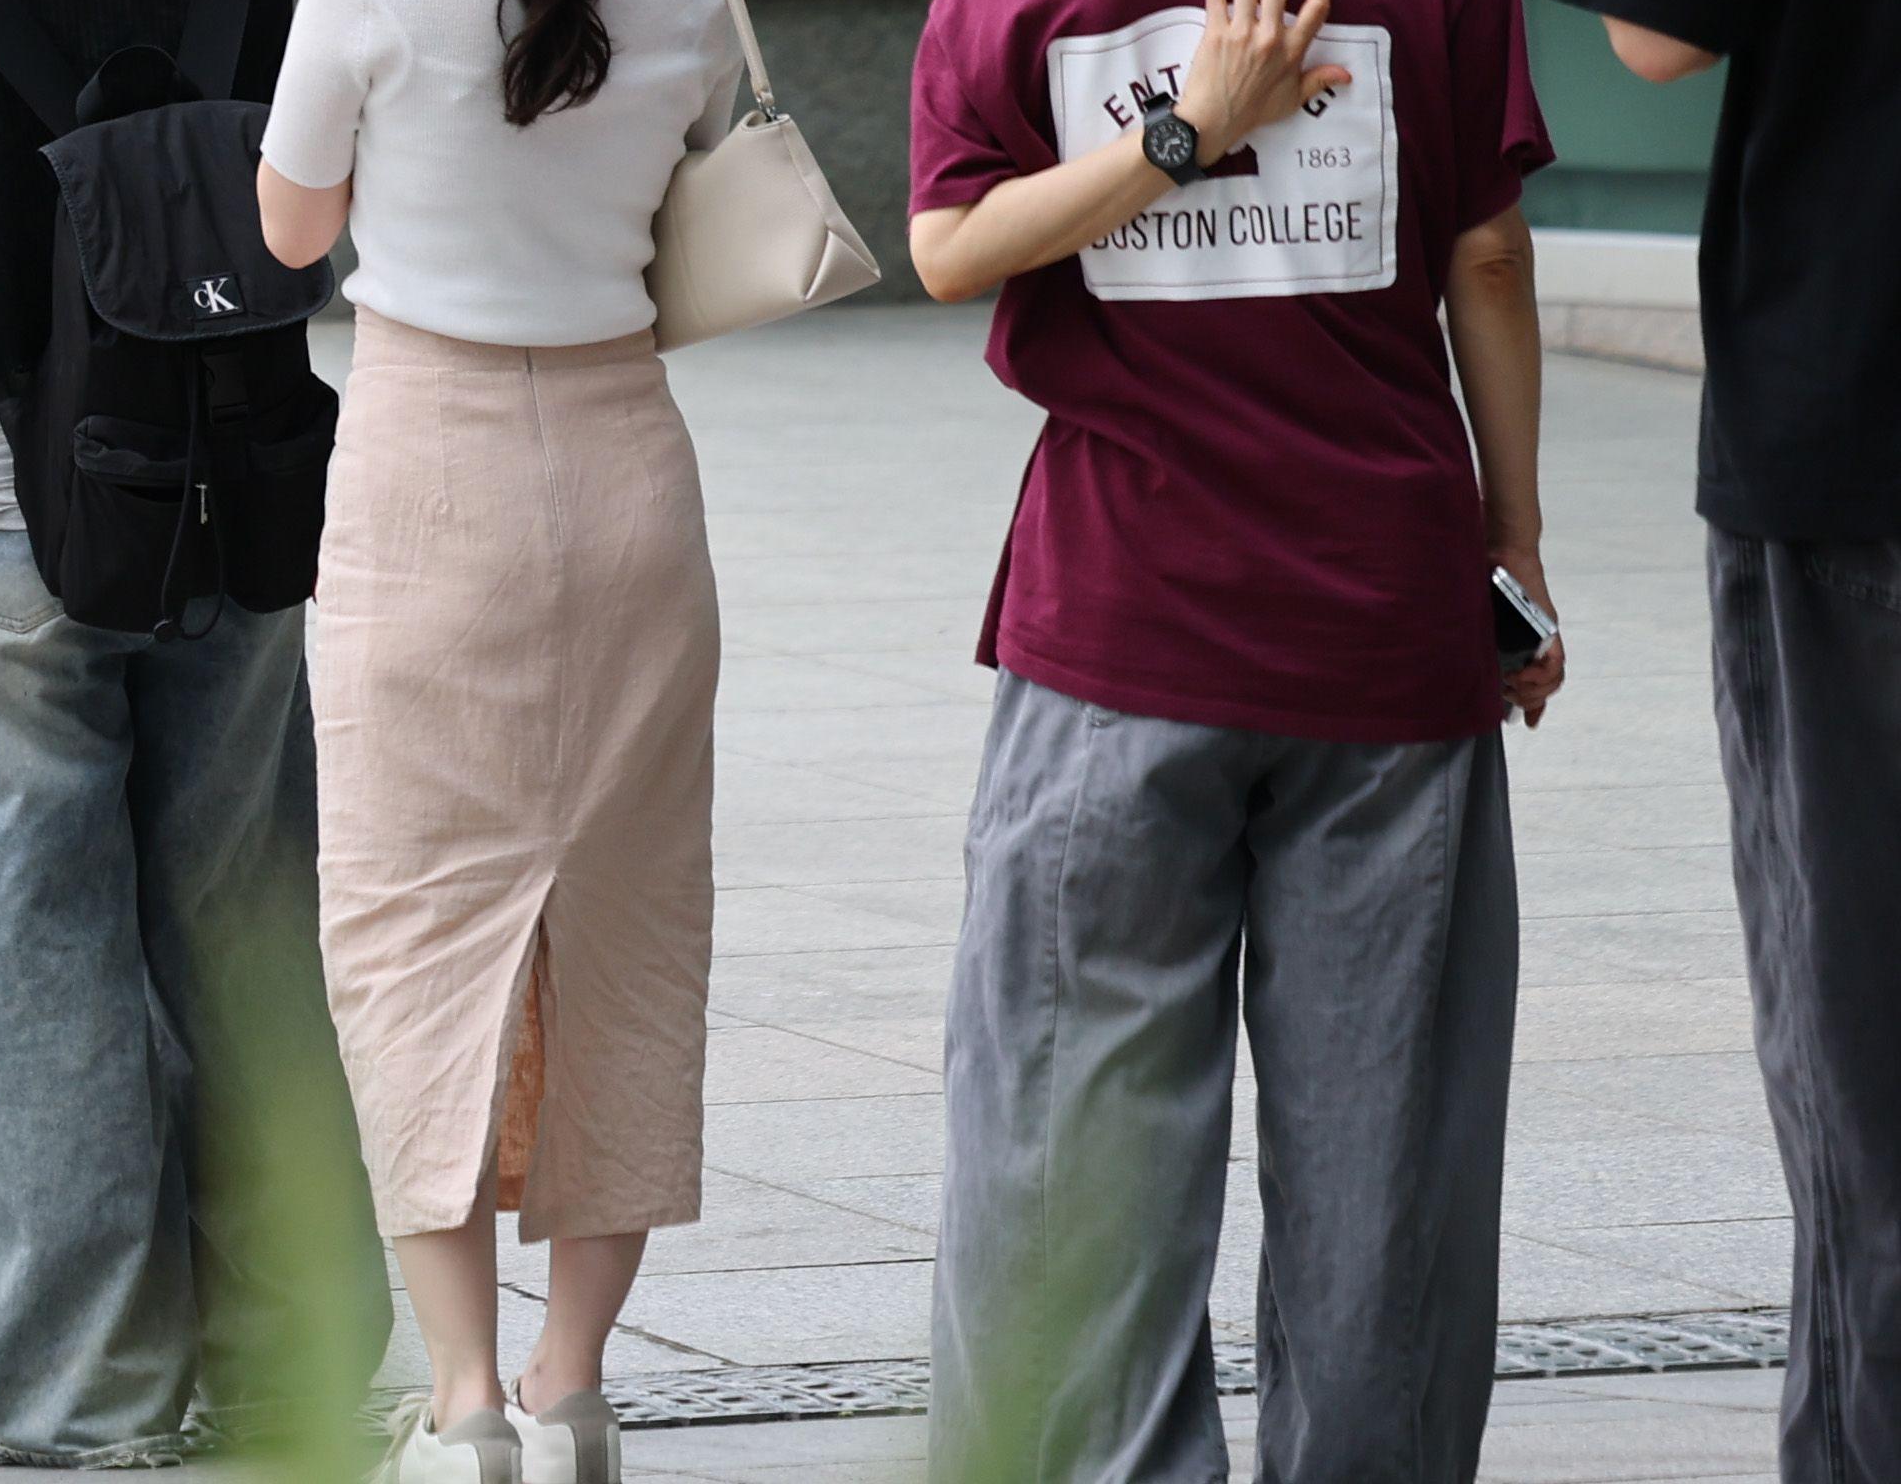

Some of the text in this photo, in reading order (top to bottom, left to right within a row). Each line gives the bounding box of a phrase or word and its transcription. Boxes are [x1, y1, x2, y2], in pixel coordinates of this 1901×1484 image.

[1103, 63, 1338, 130] ENTG
[1296, 147, 1351, 169] 1863
[1228, 202, 1363, 246] COLLEGE
